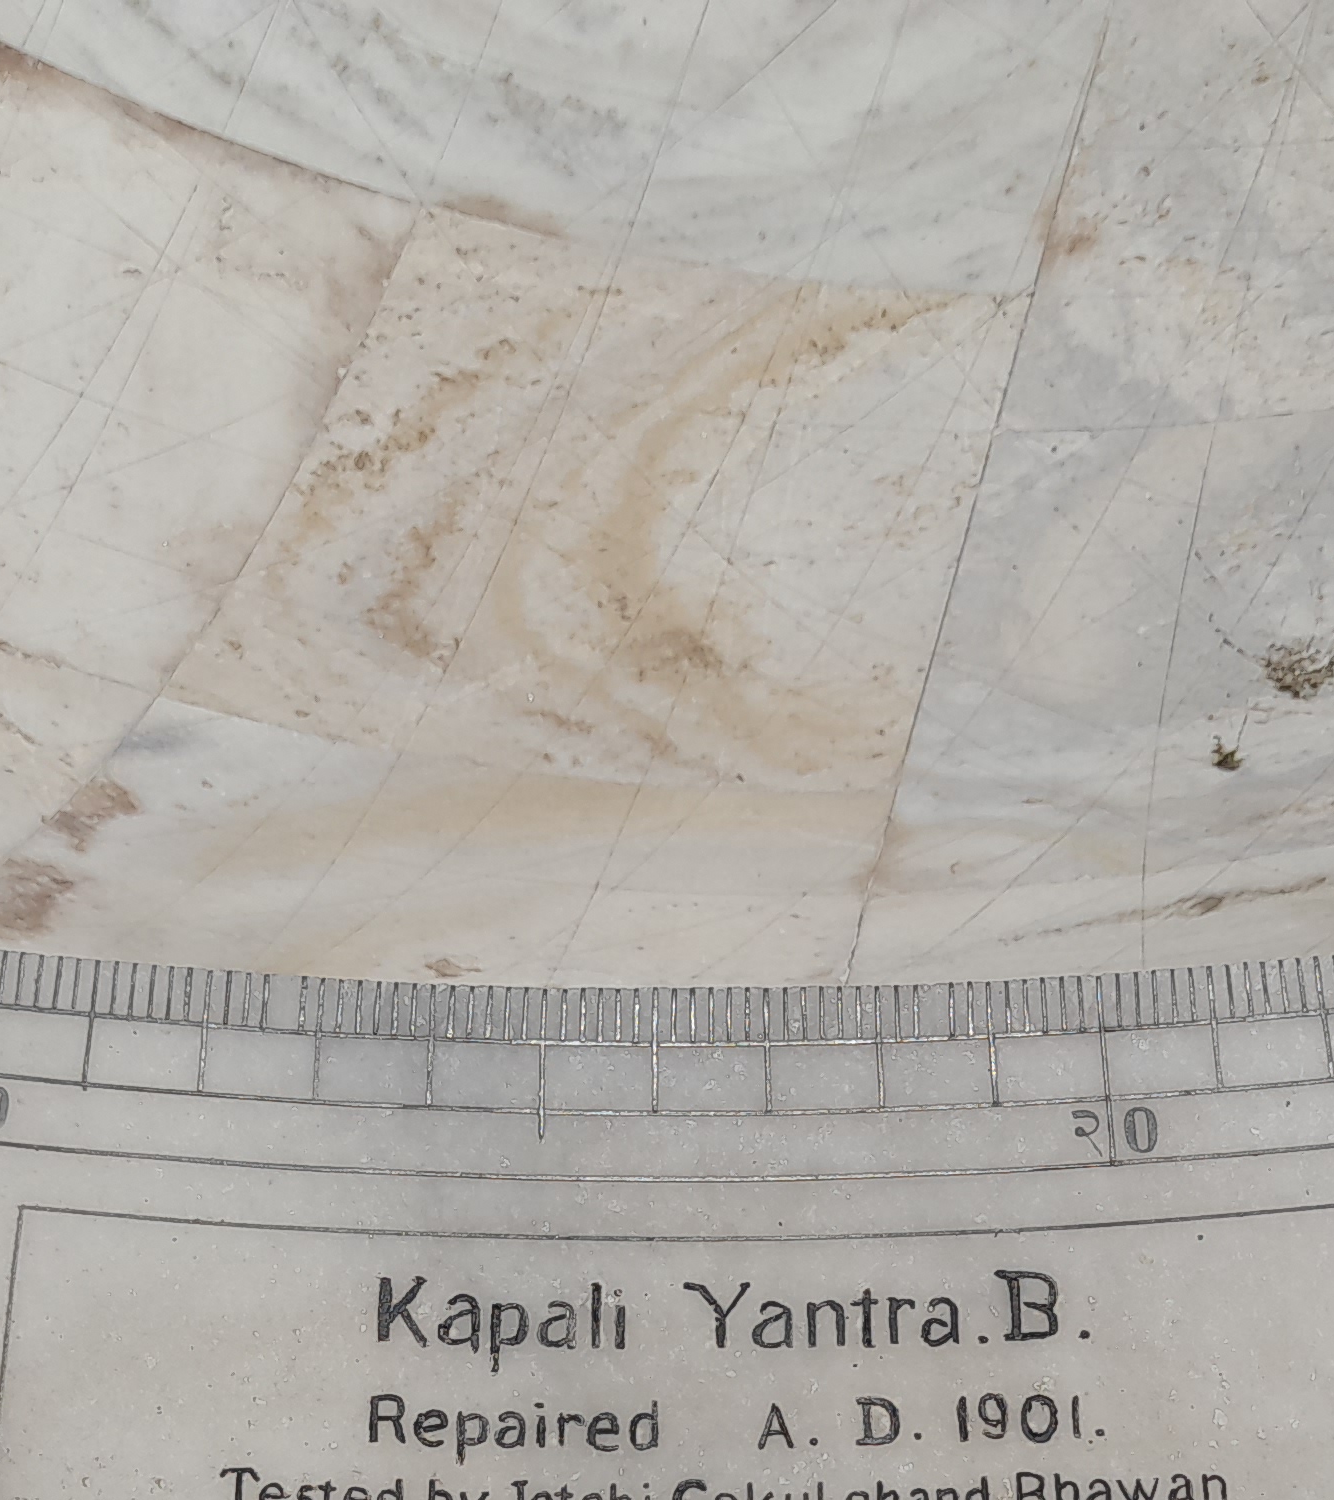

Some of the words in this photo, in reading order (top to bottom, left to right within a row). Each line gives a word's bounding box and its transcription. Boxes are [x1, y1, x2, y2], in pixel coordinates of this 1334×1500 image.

[376, 1276, 626, 1373] Kapali
[368, 1393, 658, 1465] Repaired
[956, 1393, 1106, 1443] 1901.
